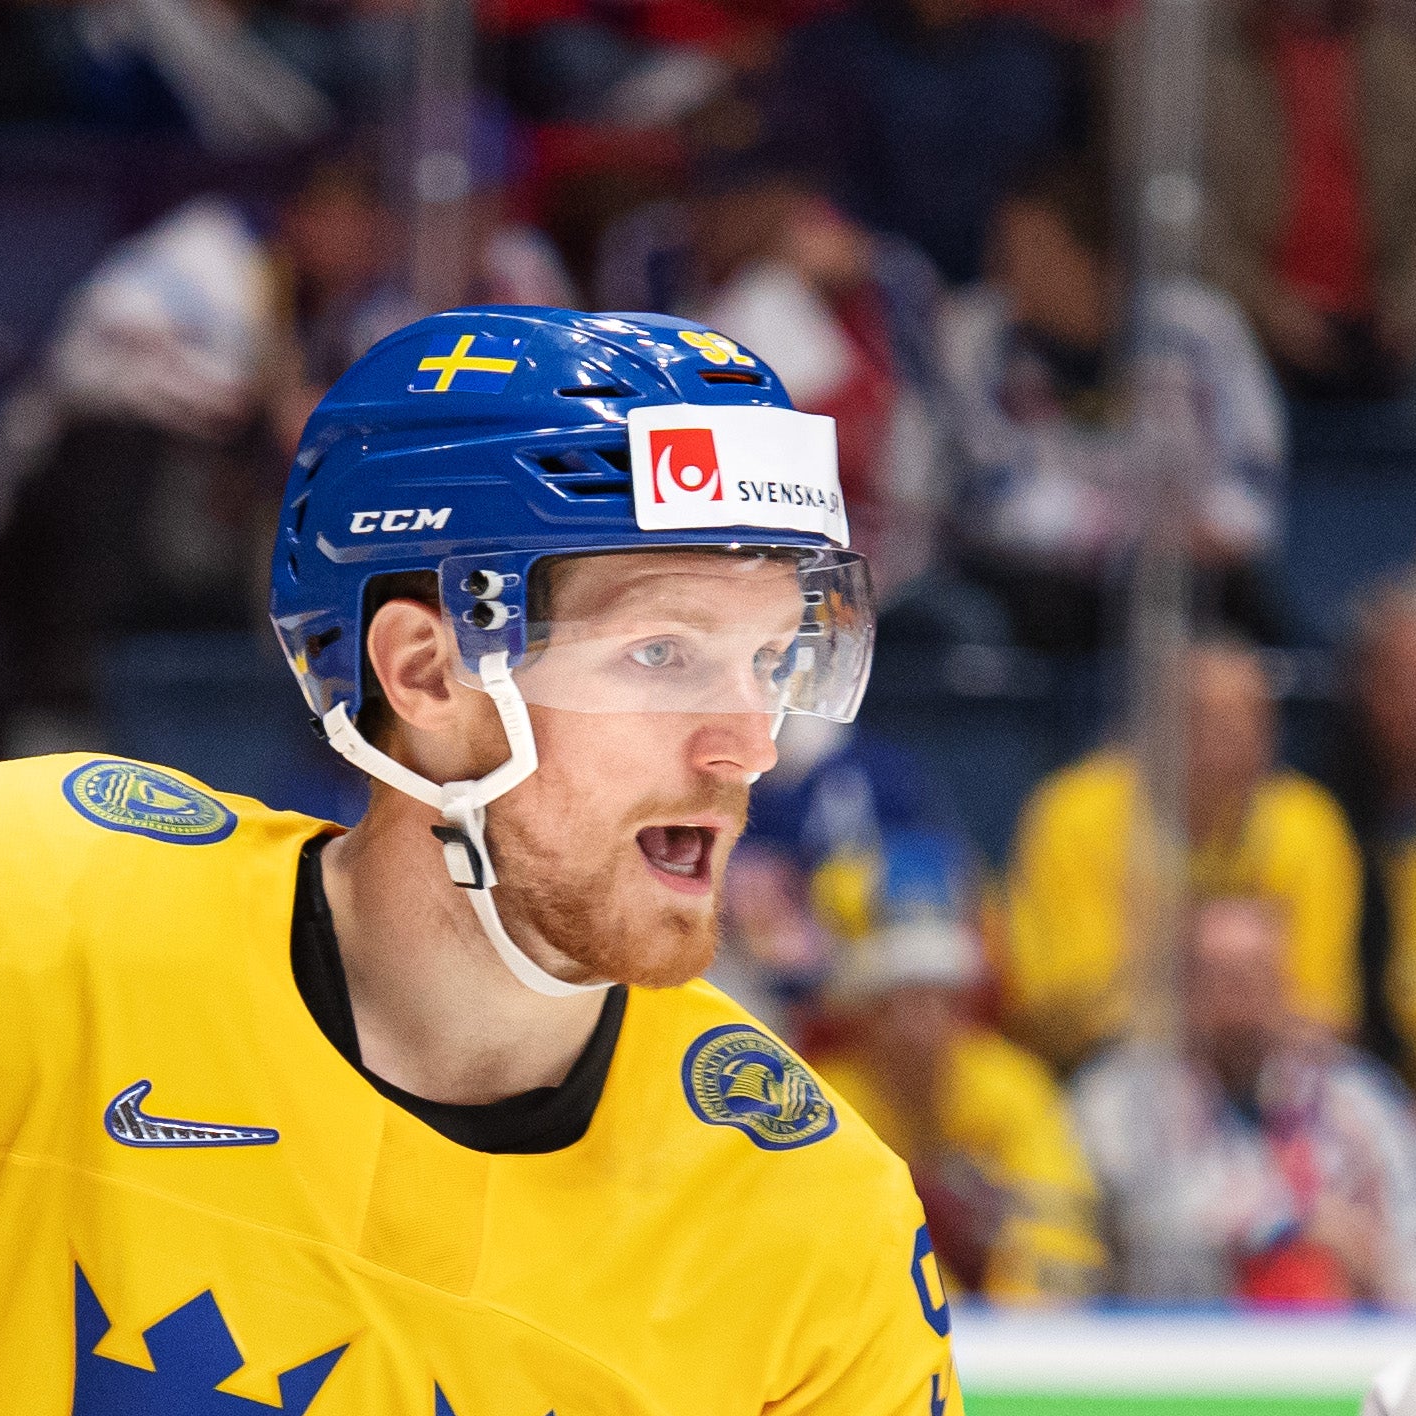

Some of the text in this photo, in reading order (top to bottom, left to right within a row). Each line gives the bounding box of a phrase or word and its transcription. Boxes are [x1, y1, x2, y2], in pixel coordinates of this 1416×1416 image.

[678, 330, 756, 368] 92
[737, 480, 826, 508] SVENSKA
[350, 508, 452, 534] CCM
